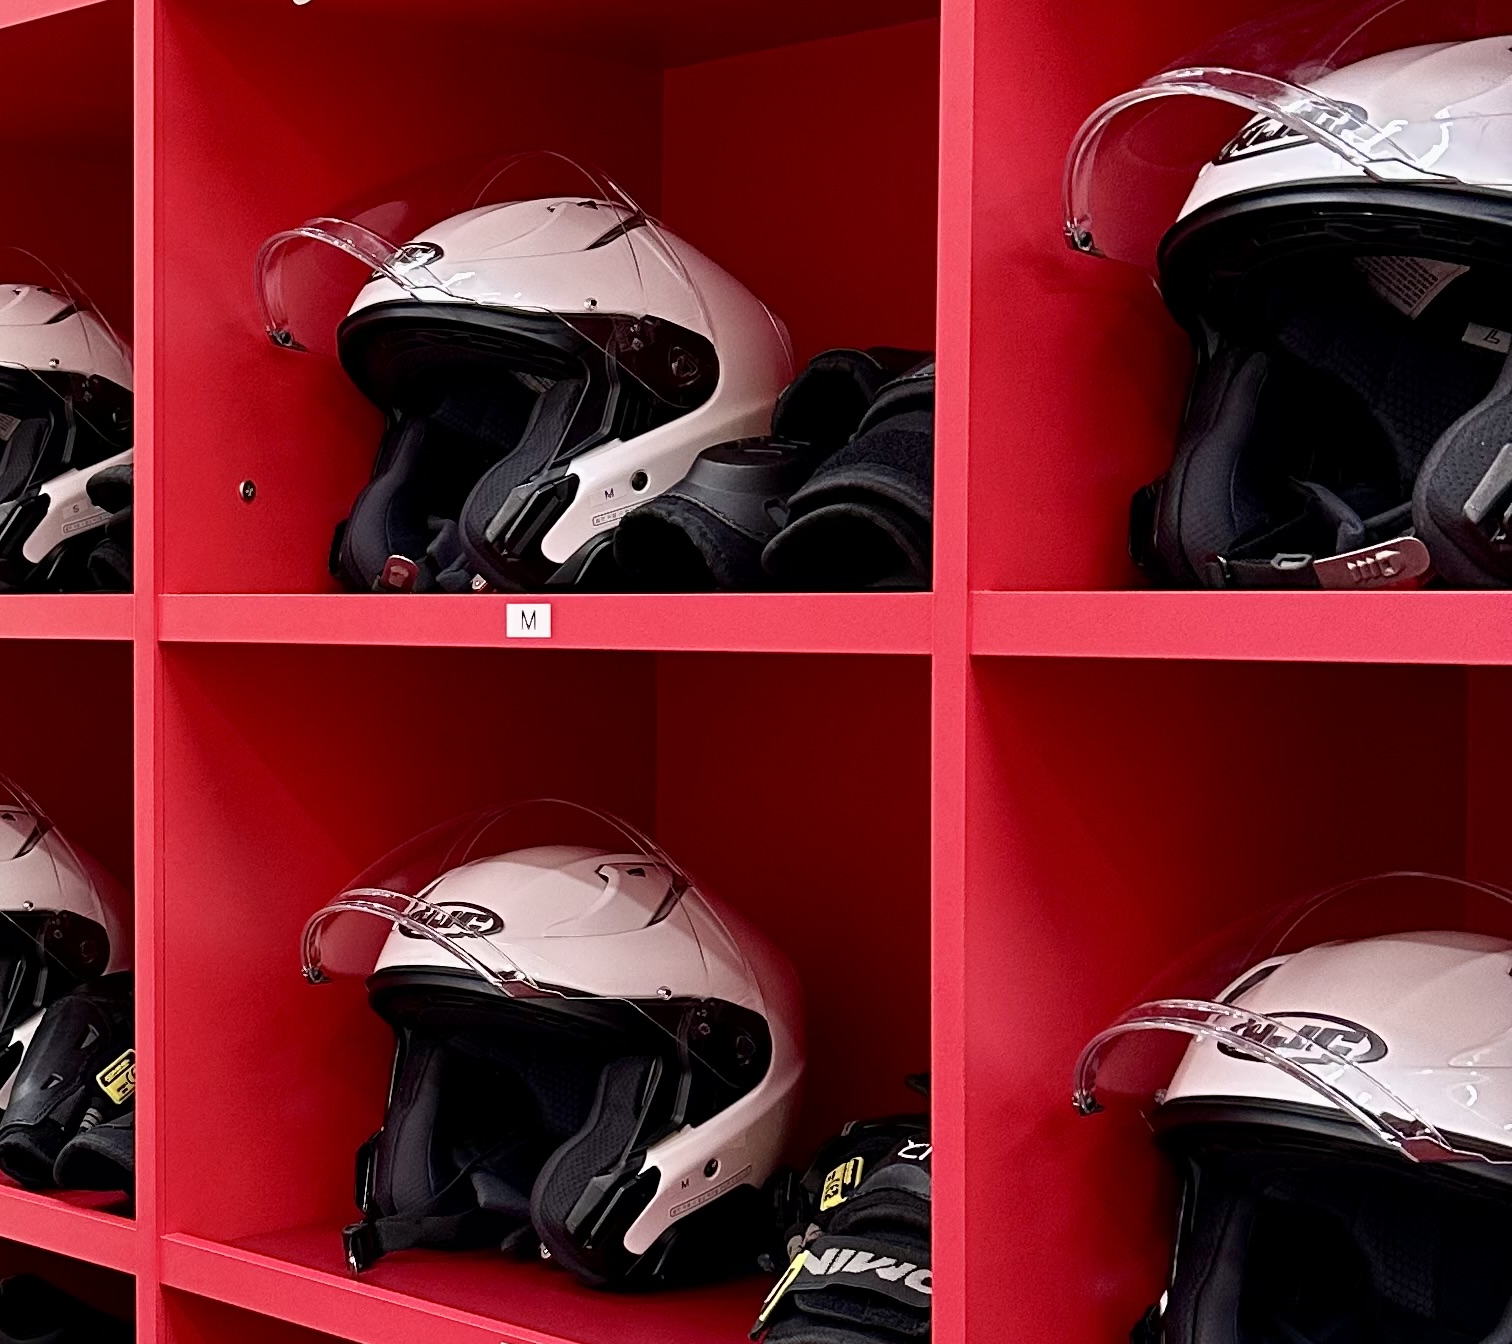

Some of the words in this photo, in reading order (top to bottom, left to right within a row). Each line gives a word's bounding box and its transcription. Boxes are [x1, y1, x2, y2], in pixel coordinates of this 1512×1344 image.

[604, 488, 615, 500] M
[72, 504, 80, 513] S
[521, 609, 537, 631] M
